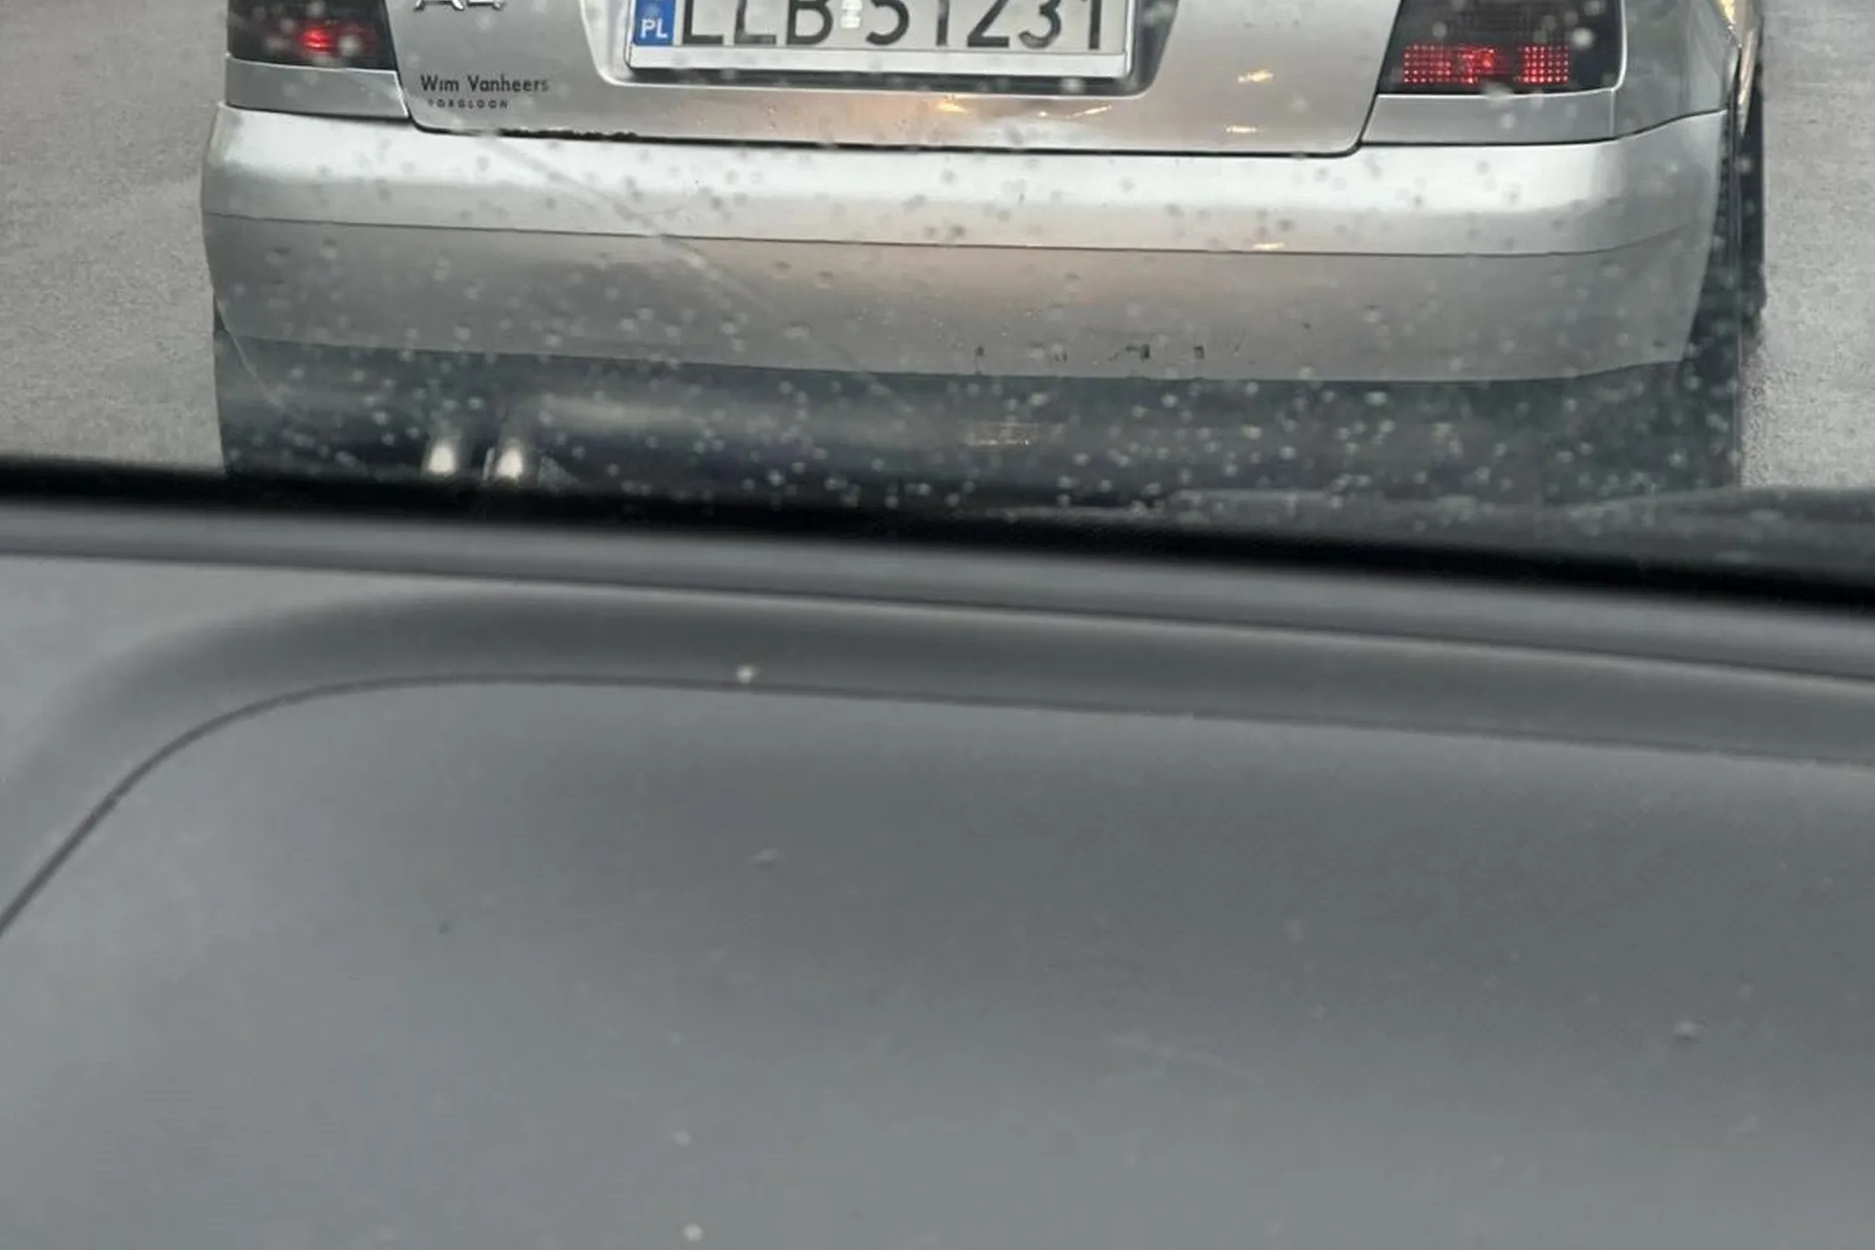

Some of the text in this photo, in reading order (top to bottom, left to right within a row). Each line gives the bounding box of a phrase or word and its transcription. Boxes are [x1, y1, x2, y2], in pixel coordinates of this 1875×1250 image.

[640, 17, 669, 40] PL
[420, 72, 550, 93] Wim Vanheers
